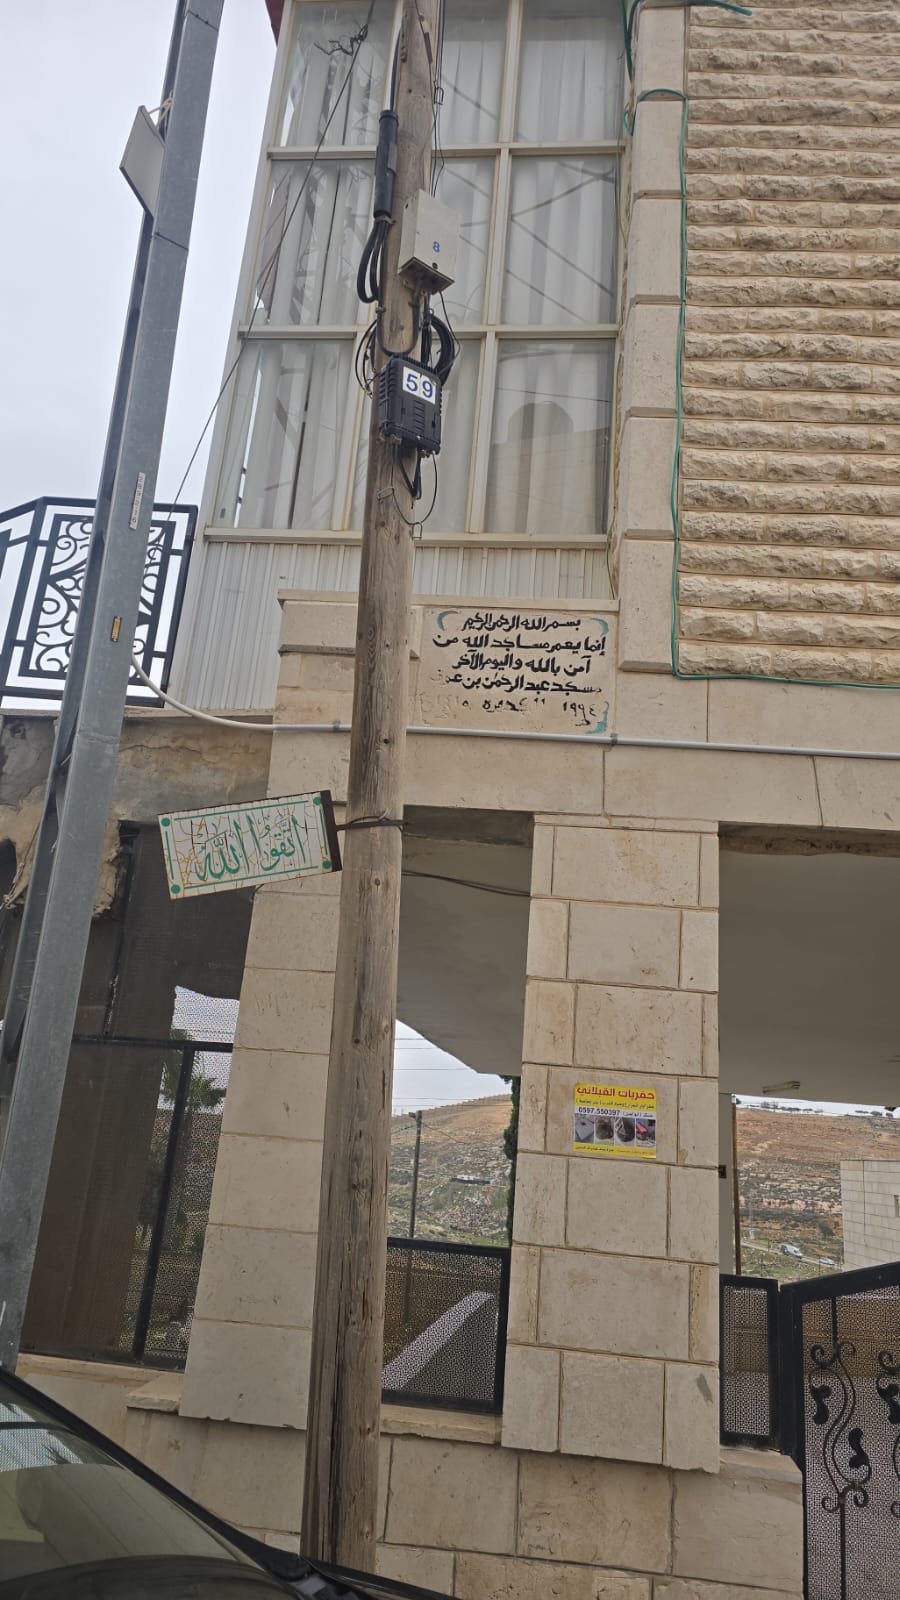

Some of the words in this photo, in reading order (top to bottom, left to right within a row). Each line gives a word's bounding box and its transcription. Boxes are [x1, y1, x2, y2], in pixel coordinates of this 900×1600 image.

[432, 240, 441, 254] 8
[406, 373, 434, 398] 59
[462, 612, 492, 631] الرحيم
[489, 614, 520, 631] الرحمن
[521, 616, 546, 630] الله
[544, 619, 581, 631] بسم
[432, 634, 458, 647] من
[463, 633, 488, 648] الله
[491, 634, 552, 652] مساجد
[549, 637, 581, 654] يعمر
[584, 636, 606, 656] إنما
[452, 649, 483, 670] الآخر
[483, 653, 523, 670] واليوم
[525, 657, 560, 677] بالله
[563, 655, 591, 676] آمن
[462, 675, 481, 689] بن
[524, 682, 551, 695] عبد
[551, 681, 602, 696] مسجد
[194, 820, 250, 881] الله
[618, 1089, 655, 1100] حفريات
